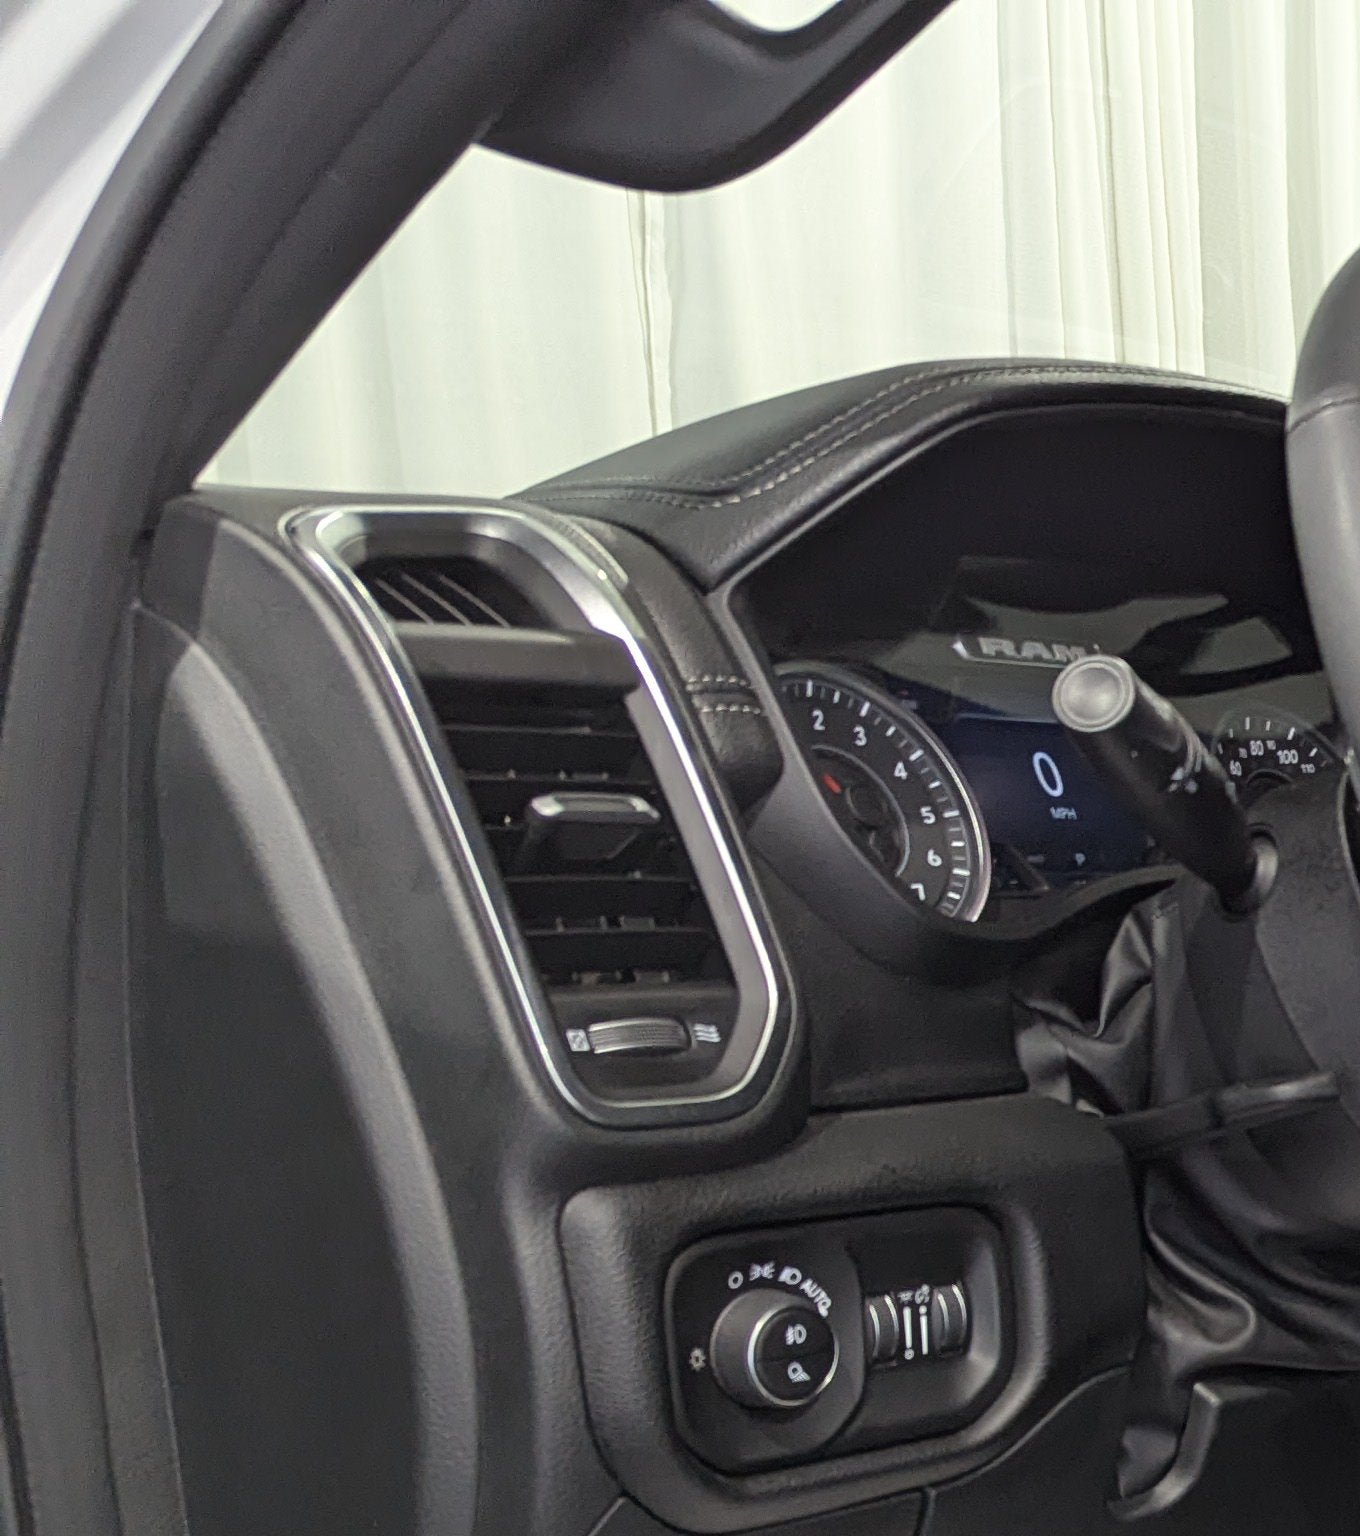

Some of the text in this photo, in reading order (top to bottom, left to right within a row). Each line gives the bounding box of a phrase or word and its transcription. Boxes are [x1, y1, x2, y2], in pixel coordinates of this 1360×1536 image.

[977, 636, 1087, 662] RAM
[812, 709, 826, 731] 2
[853, 725, 867, 746] 3
[1276, 748, 1299, 765] 100
[893, 761, 908, 780] 4
[1032, 751, 1064, 798] 0
[919, 806, 936, 824] 5
[927, 848, 942, 867] 6
[909, 882, 926, 901] 7
